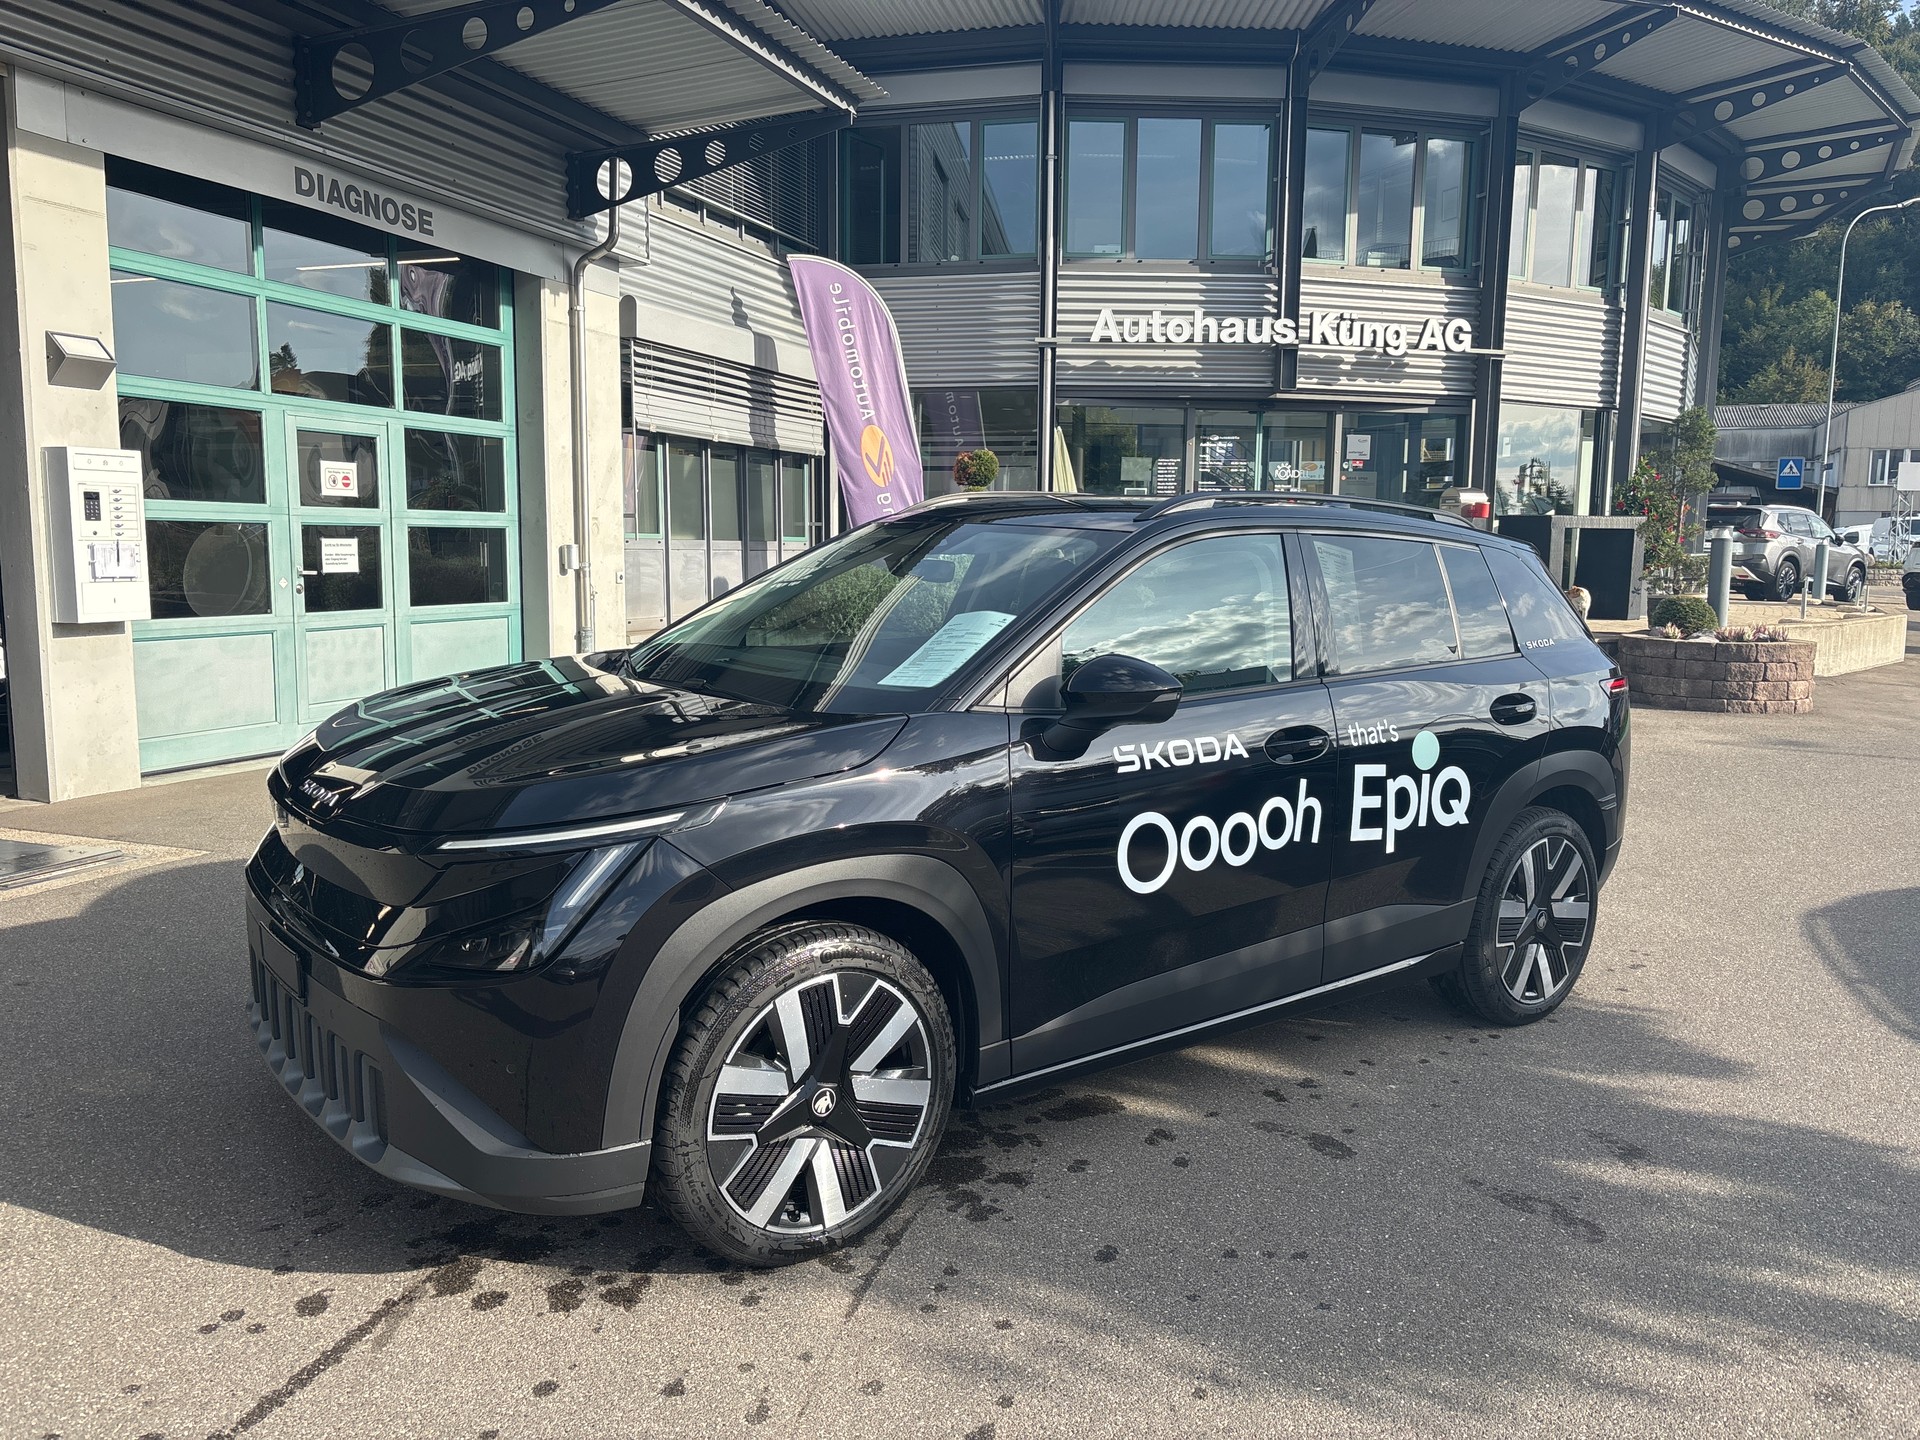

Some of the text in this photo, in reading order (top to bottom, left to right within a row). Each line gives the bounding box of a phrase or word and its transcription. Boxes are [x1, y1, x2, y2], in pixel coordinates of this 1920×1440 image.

[294, 165, 435, 237] DIAGNOSE
[1089, 307, 1472, 356] Autohaus Küng AG
[1347, 718, 1400, 747] that's
[1117, 730, 1471, 894] Ooooh EpiQ
